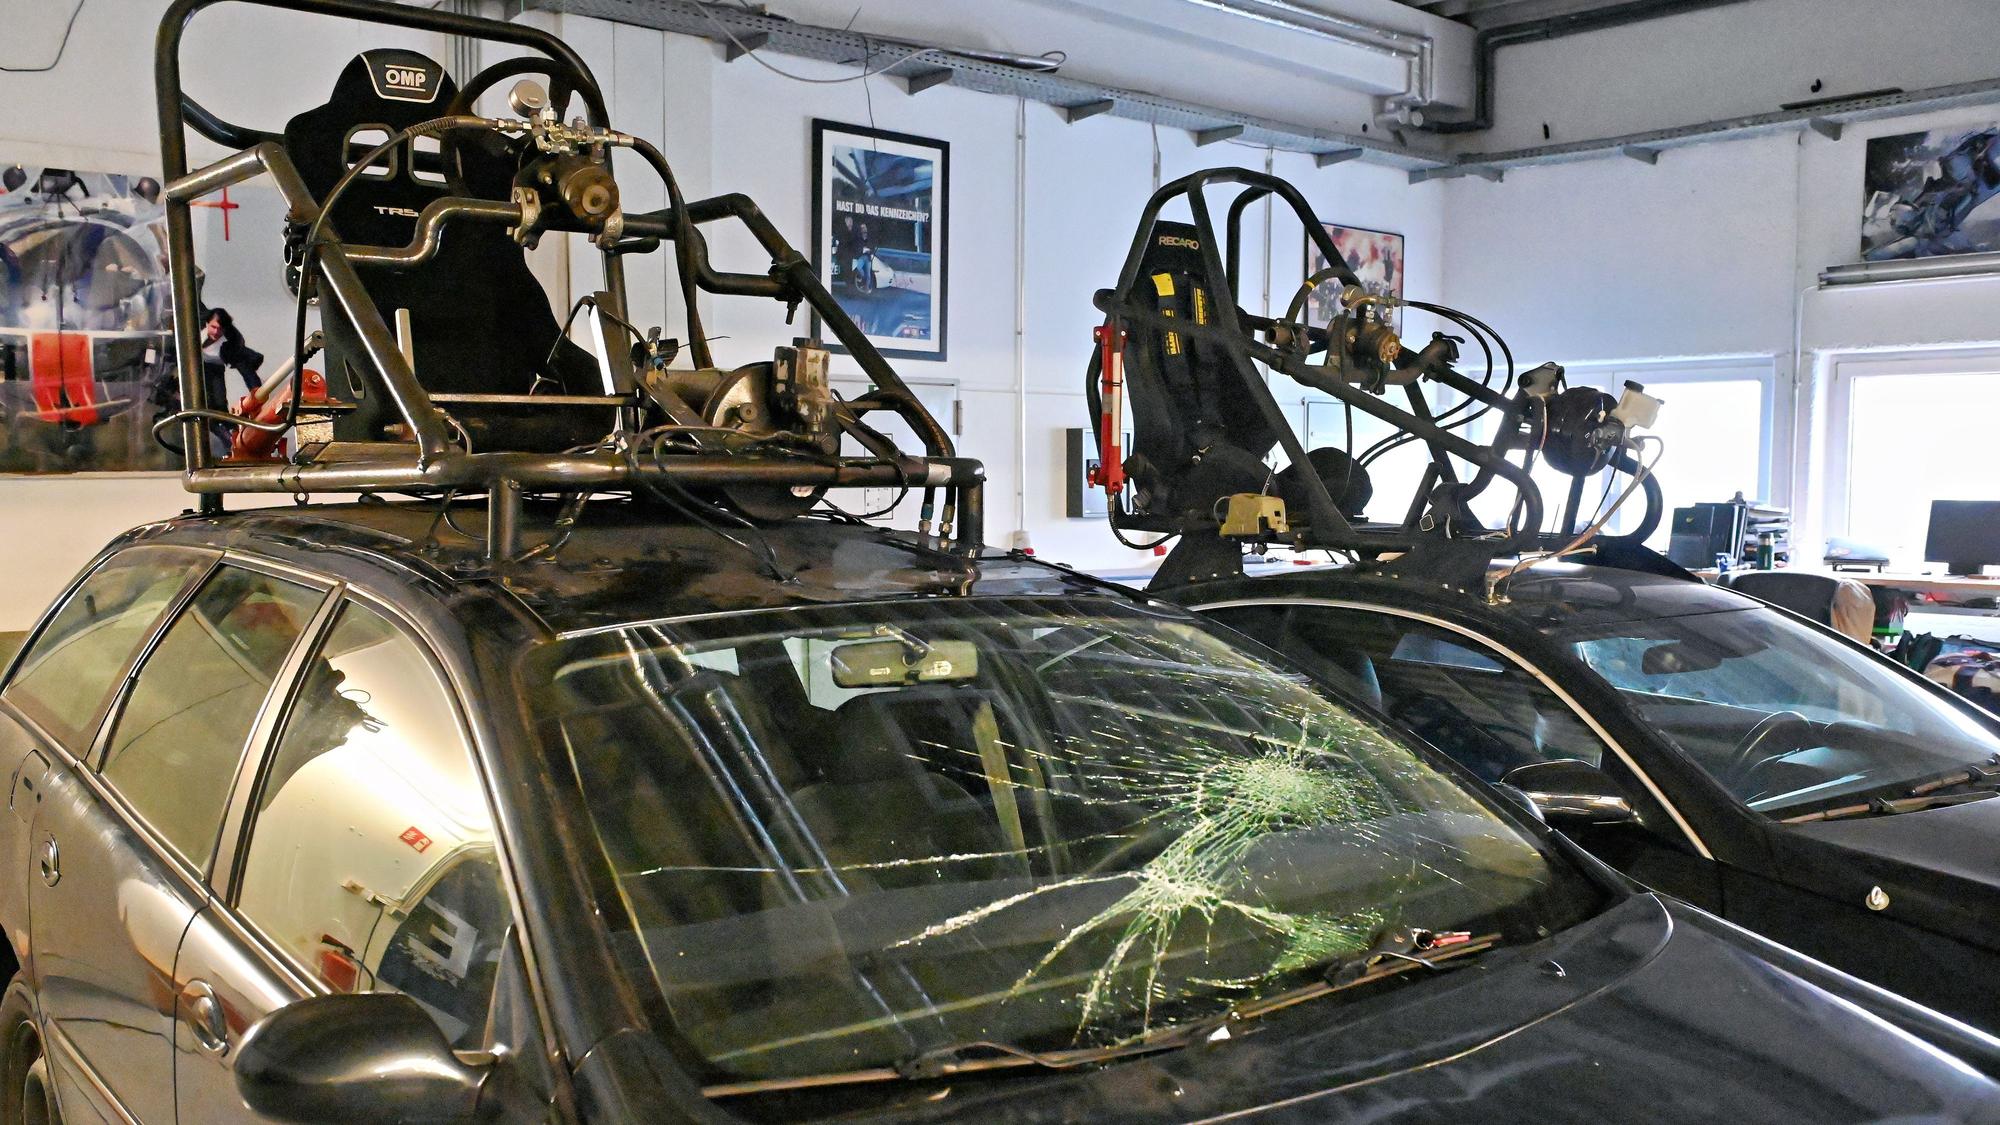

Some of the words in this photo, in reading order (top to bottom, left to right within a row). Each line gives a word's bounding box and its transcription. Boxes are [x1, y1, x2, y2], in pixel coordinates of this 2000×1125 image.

[385, 69, 426, 87] OMP
[836, 200, 854, 213] HAST
[855, 202, 865, 214] DU
[865, 204, 879, 217] DAS
[880, 206, 930, 223] KENNZEICHEN?
[1158, 235, 1200, 250] RECARO
